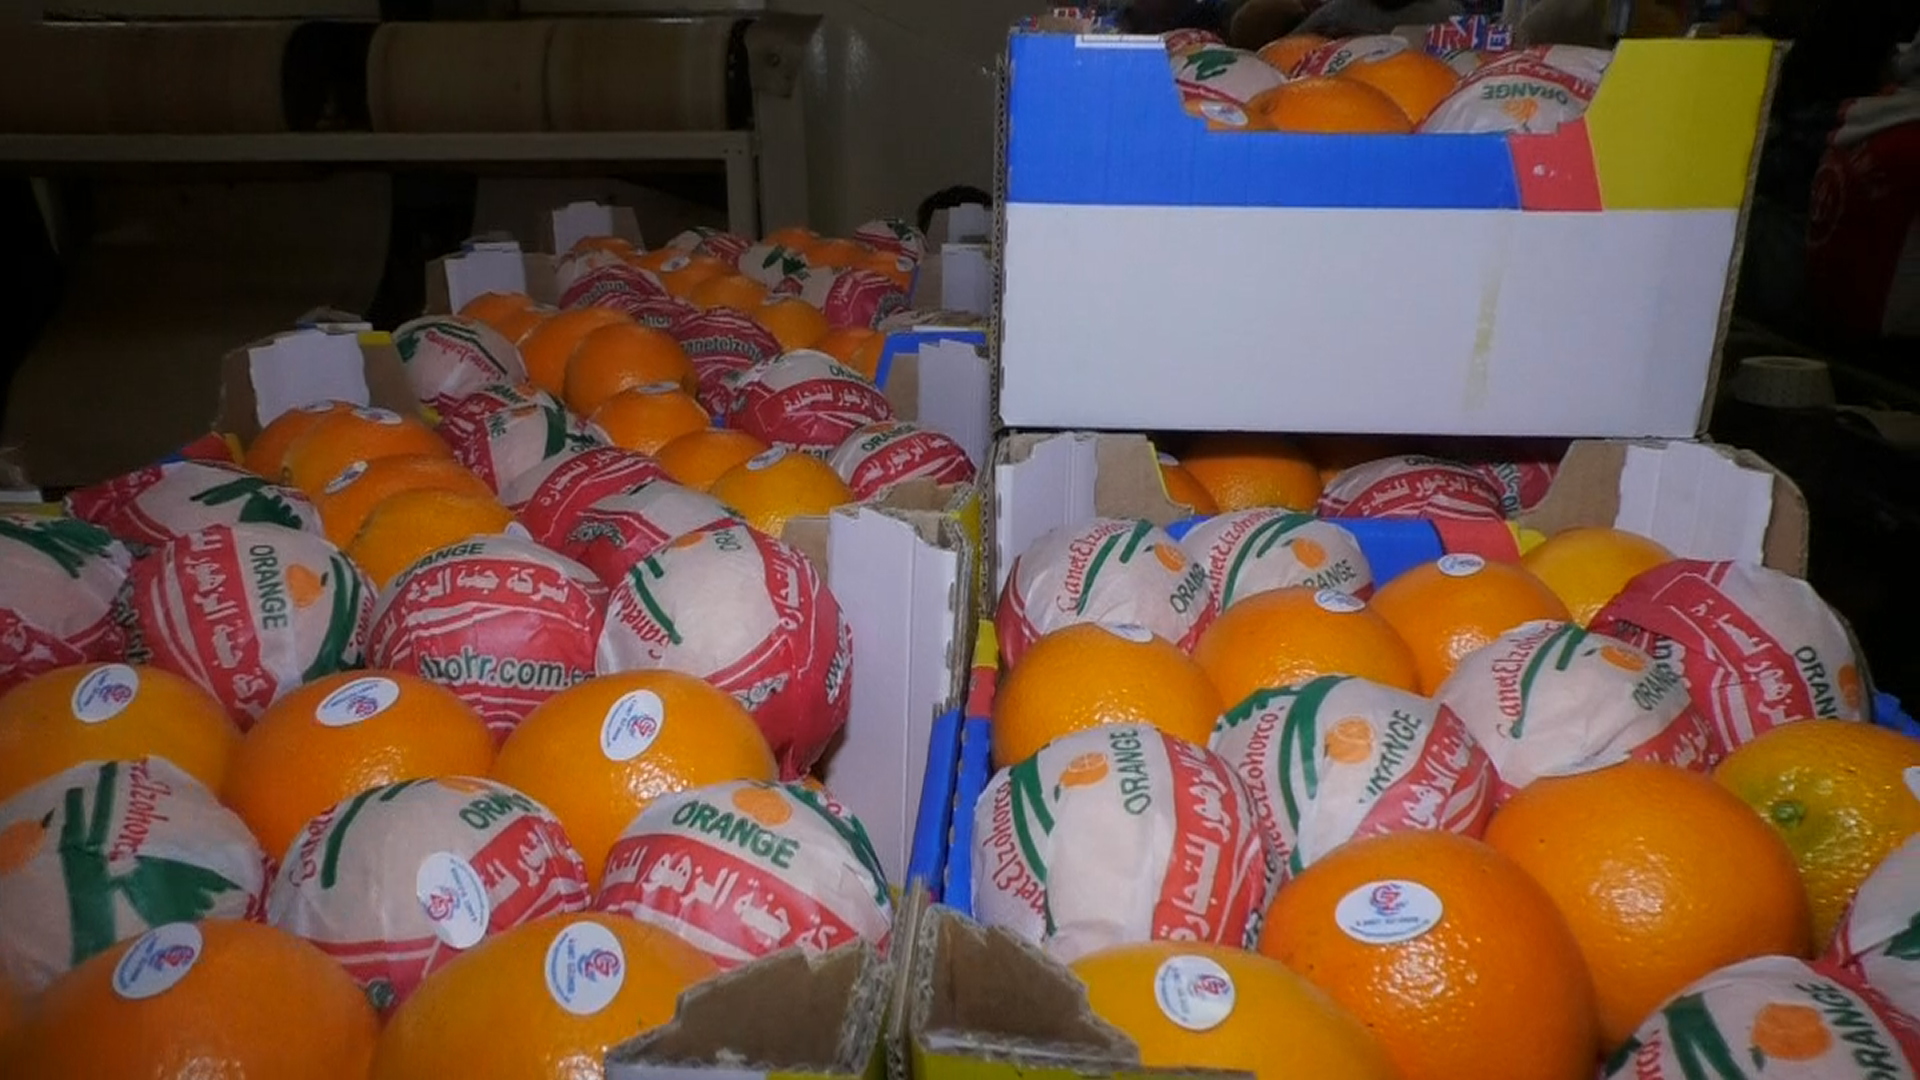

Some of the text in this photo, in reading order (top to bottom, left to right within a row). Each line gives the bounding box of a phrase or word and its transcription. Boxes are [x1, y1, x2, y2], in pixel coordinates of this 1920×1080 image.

[1481, 84, 1569, 105] ORANGE
[249, 544, 288, 630] ORANGE
[457, 565, 500, 595] جنة
[506, 566, 569, 603] شركة
[212, 619, 244, 668] جنة
[1794, 645, 1839, 720] ORAN
[1121, 727, 1152, 816] ORANGE
[671, 799, 799, 870] ORANGE
[734, 877, 791, 946] جنة
[1160, 832, 1221, 944] للتجارة
